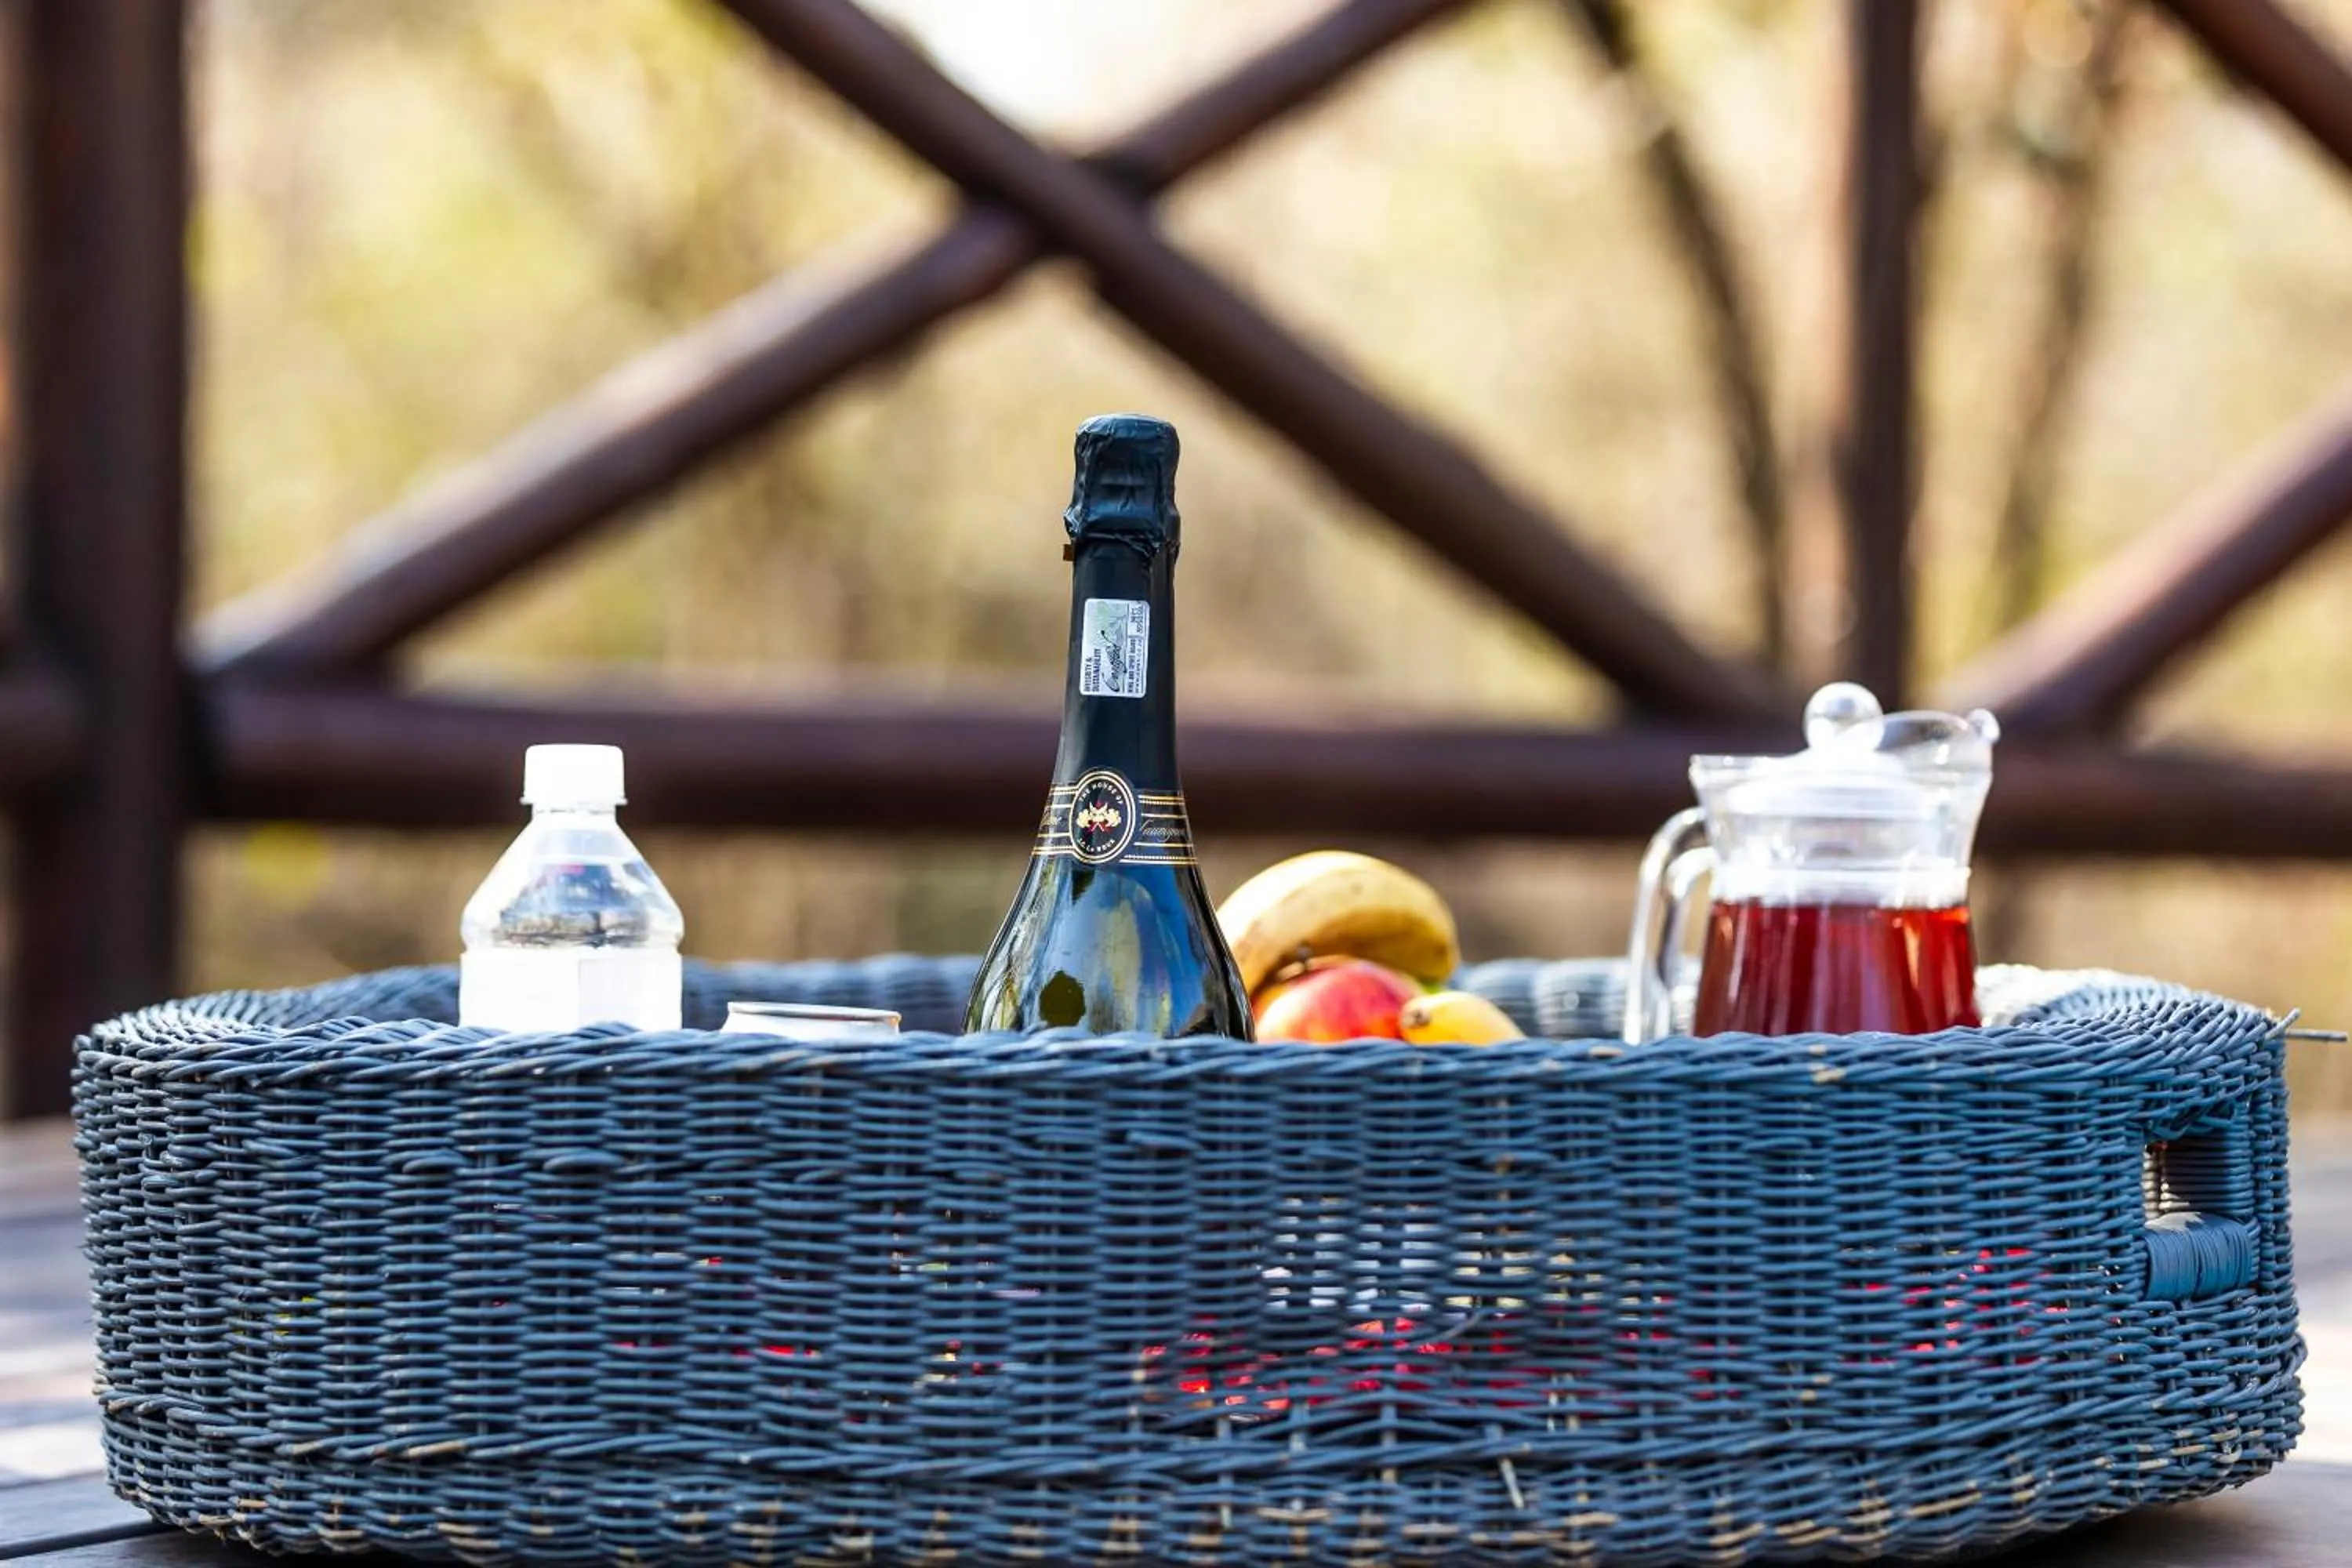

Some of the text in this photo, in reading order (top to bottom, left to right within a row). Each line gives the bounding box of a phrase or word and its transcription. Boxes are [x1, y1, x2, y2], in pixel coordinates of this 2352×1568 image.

[1079, 782, 1123, 804] THE HOUSE OF
[1096, 839, 1116, 851] ROUX
